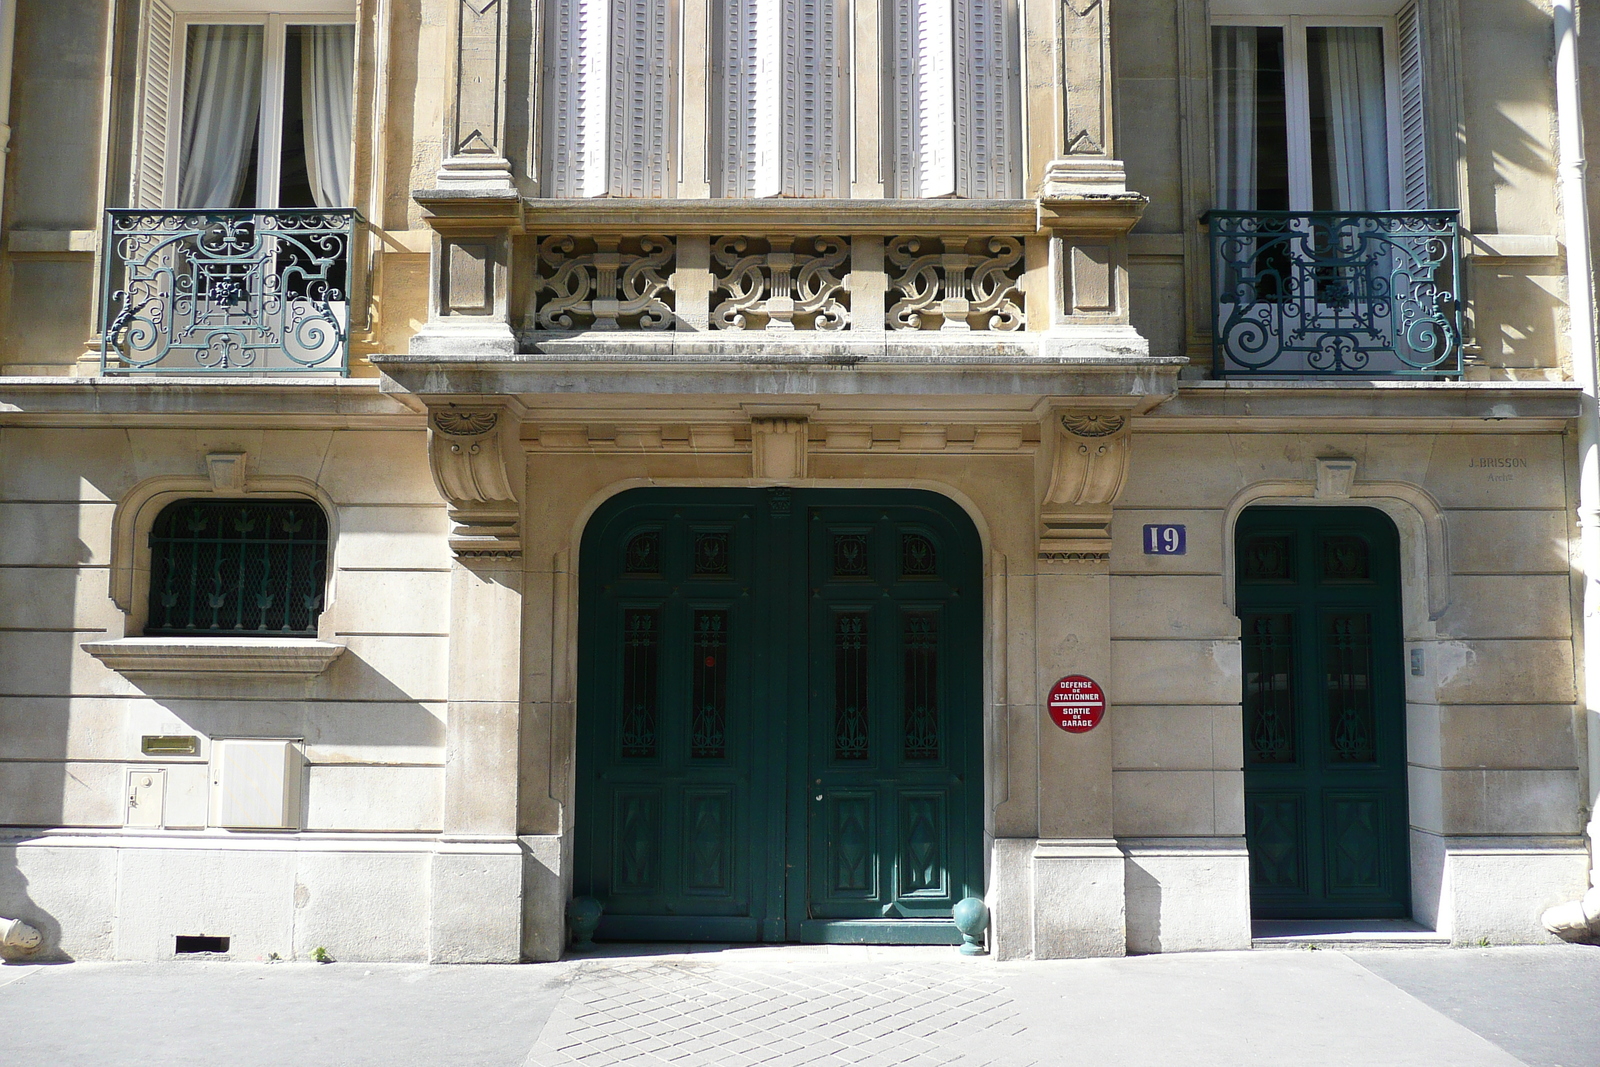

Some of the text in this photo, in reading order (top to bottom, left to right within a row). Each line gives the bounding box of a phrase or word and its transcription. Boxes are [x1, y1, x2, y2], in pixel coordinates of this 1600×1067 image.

[1480, 457, 1527, 468] BRISSON
[1150, 527, 1179, 552] 19
[1054, 693, 1099, 701] STATIONNER
[1062, 719, 1092, 727] GARAGE
